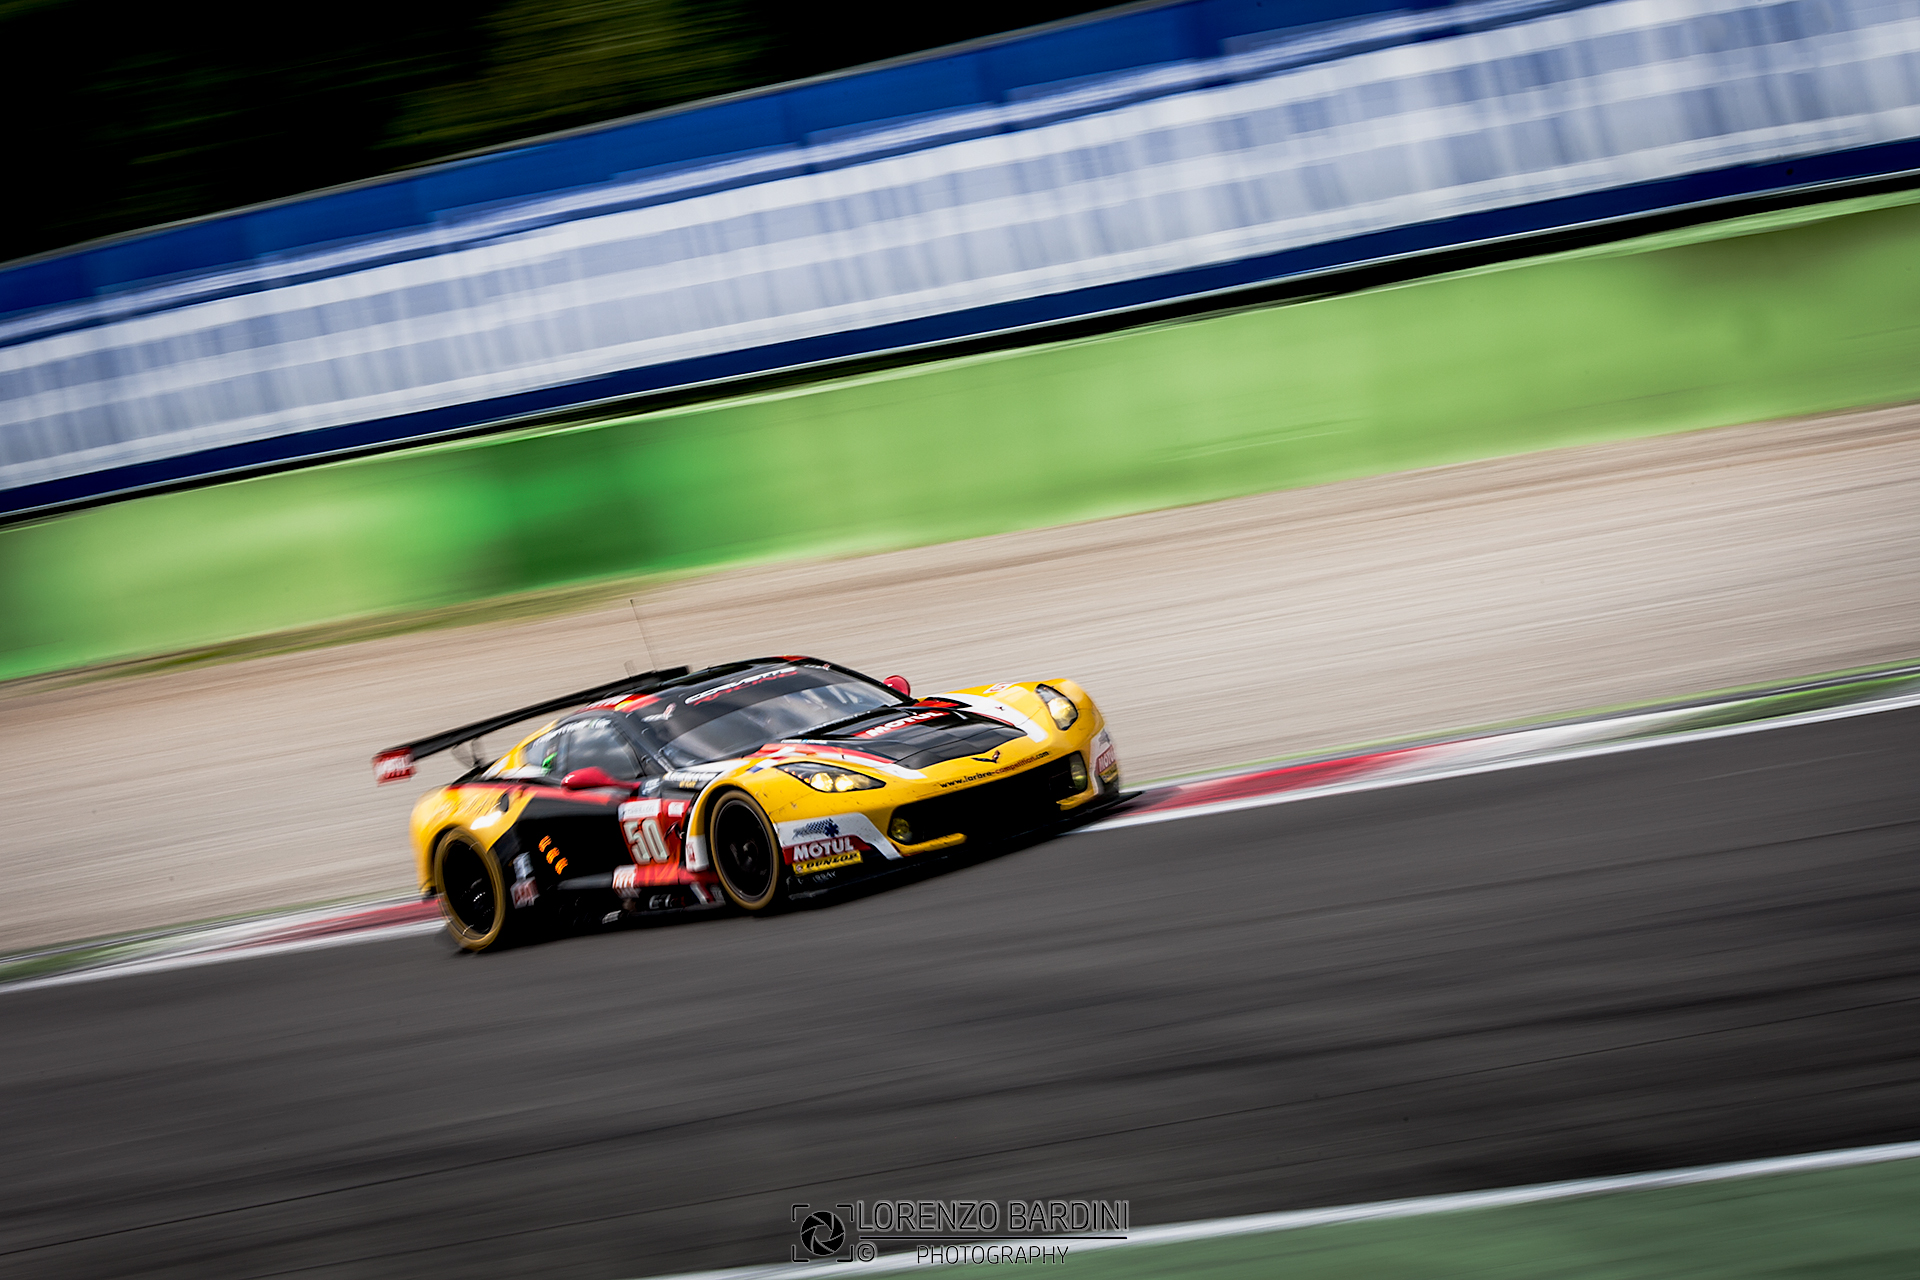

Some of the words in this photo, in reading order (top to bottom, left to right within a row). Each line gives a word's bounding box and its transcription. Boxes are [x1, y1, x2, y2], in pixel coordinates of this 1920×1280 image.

[865, 709, 946, 738] MOTUL
[623, 818, 670, 865] 50
[793, 836, 854, 862] MOTUL
[804, 852, 859, 870] DUNLOP
